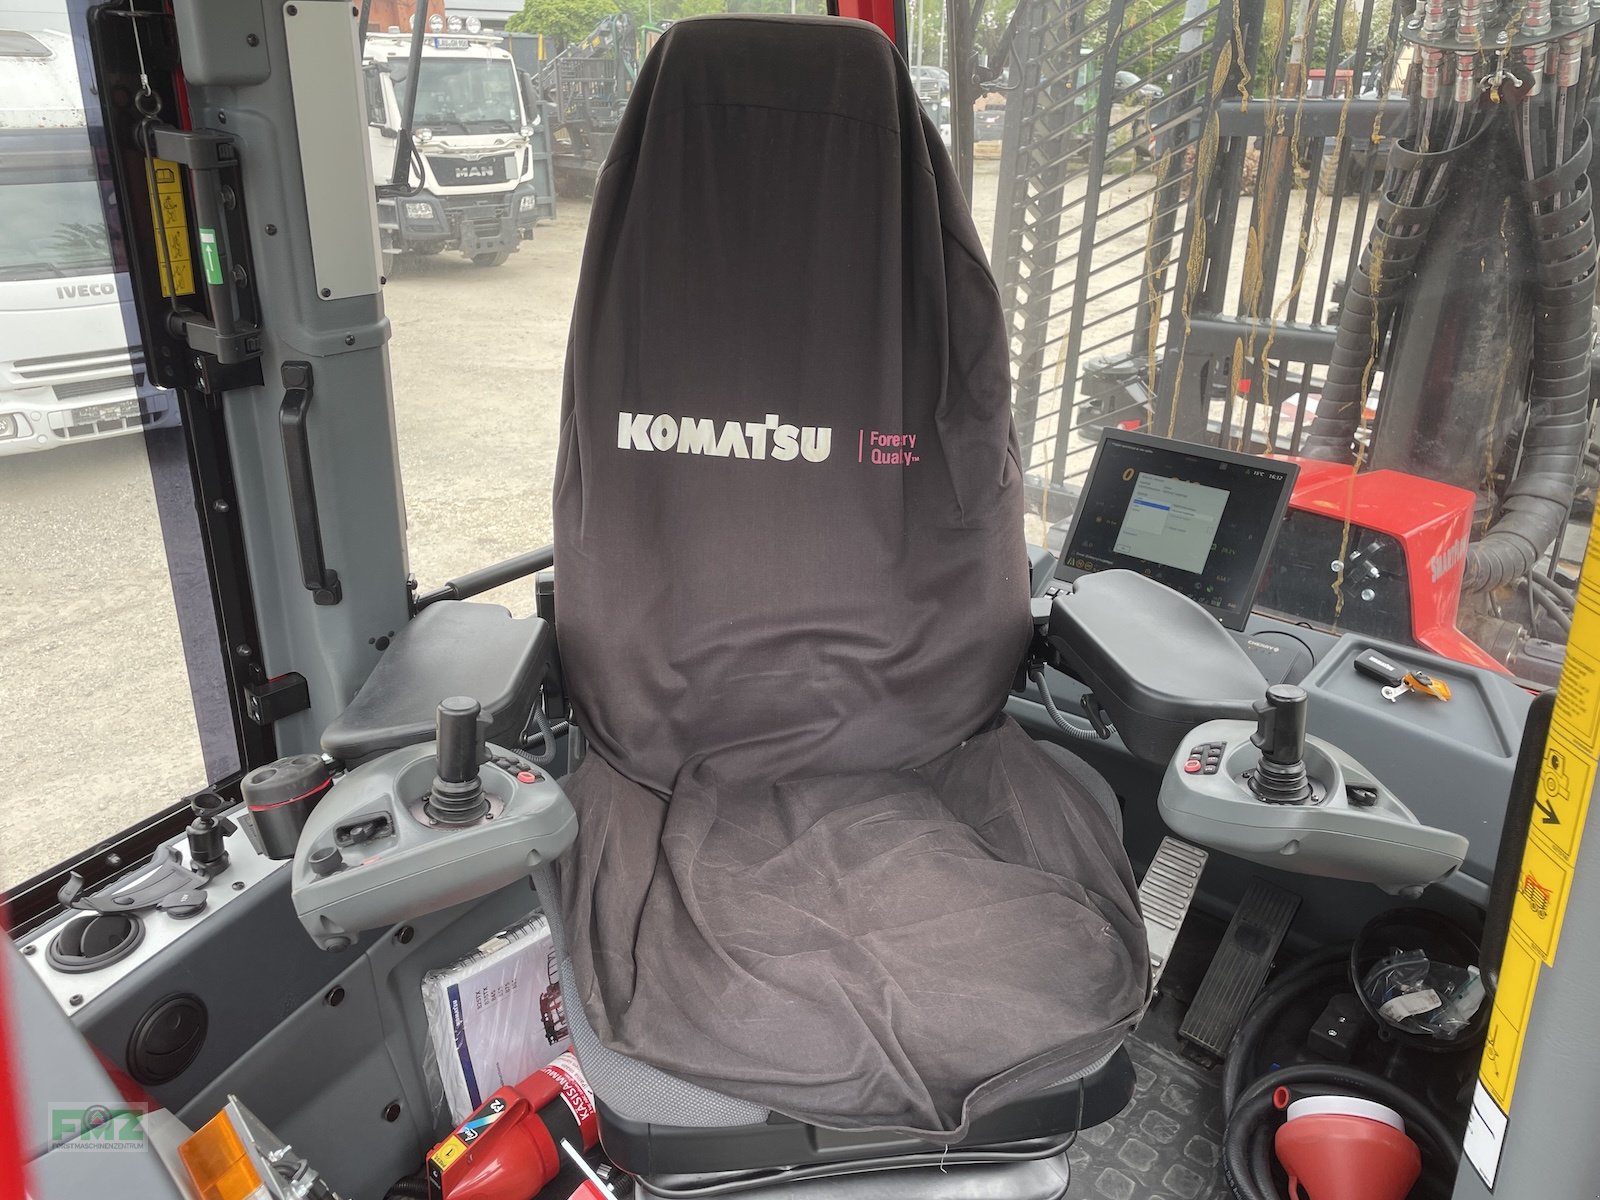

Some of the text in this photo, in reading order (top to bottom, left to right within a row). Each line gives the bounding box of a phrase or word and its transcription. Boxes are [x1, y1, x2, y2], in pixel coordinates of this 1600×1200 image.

[455, 166, 494, 178] MAN
[56, 283, 115, 299] IVECO
[617, 411, 833, 463] KOMATSU
